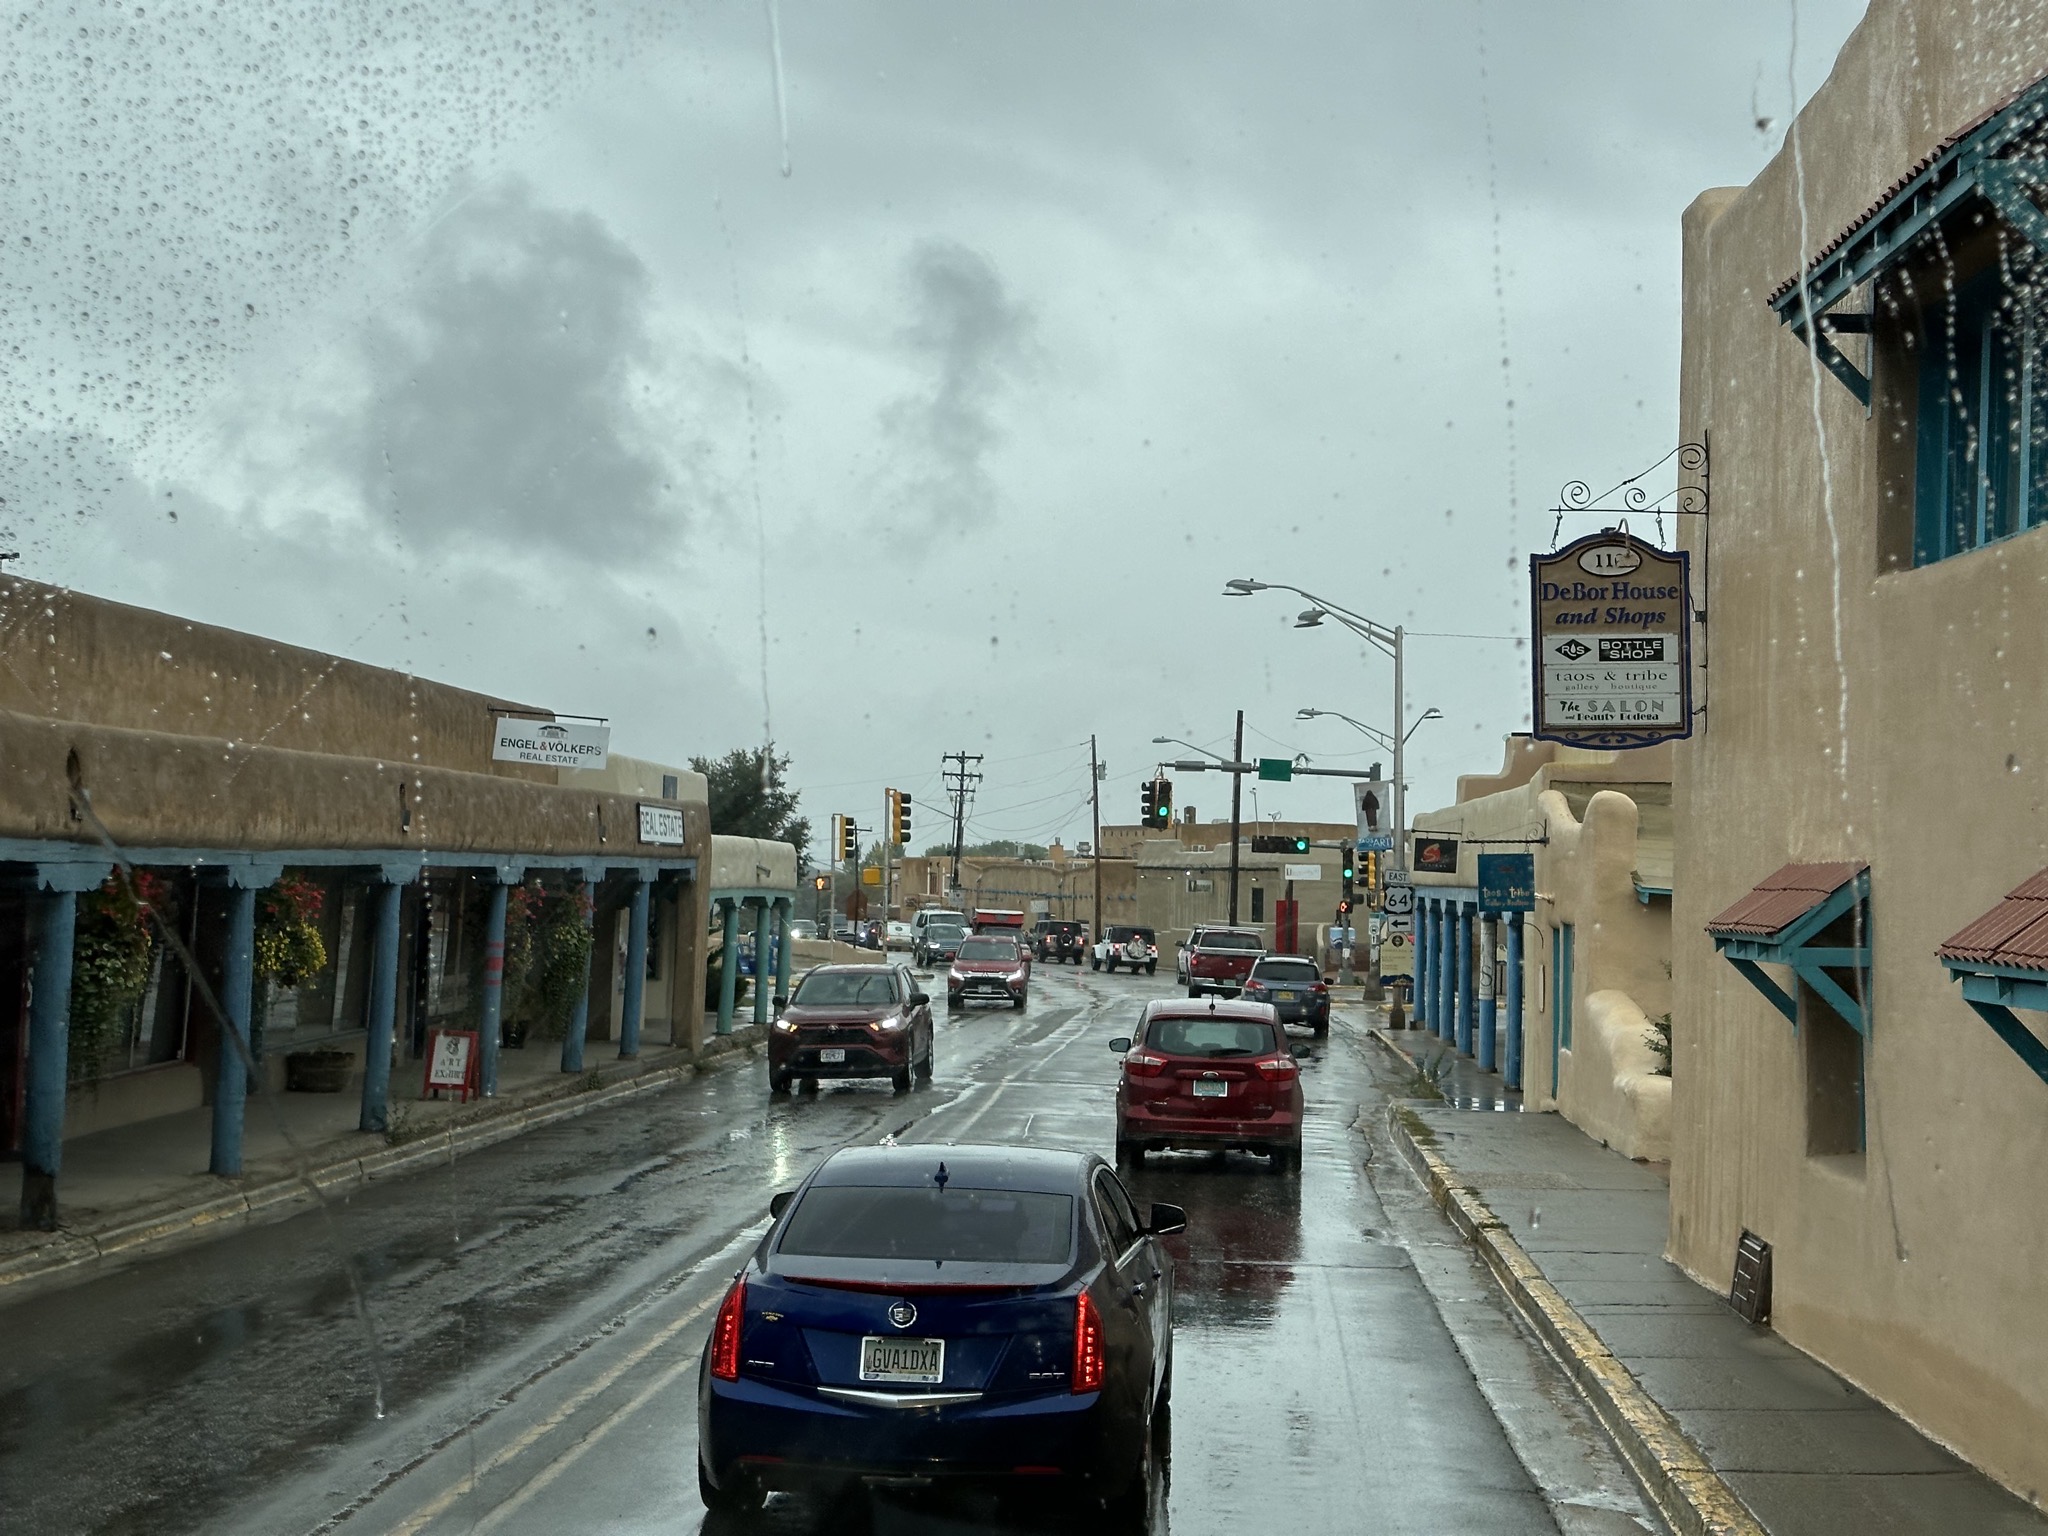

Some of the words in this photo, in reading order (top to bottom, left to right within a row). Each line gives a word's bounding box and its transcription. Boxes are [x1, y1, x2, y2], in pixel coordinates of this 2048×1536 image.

[1541, 582, 1609, 601] DeBor
[1611, 581, 1679, 600] House
[1555, 607, 1598, 625] and
[1604, 606, 1667, 630] Shops
[1600, 640, 1662, 650] BOTTLE
[1609, 649, 1655, 659] SHOP
[1556, 672, 1595, 681] taos
[1604, 670, 1616, 681] &
[1625, 669, 1668, 681] tribe
[1565, 683, 1599, 691] gallery
[1610, 682, 1658, 691] boutique
[1559, 700, 1580, 712] The
[1587, 699, 1664, 712] SALON
[1577, 712, 1615, 721] Beauty
[1620, 712, 1659, 721] Bodega
[519, 751, 544, 762] REAL
[545, 754, 579, 765] ESTATE
[640, 811, 659, 836] REAL
[659, 813, 683, 838] ESTATE
[1373, 837, 1390, 847] ART
[1388, 872, 1408, 882] EAST
[1388, 894, 1408, 907] 64
[440, 1058, 461, 1066] ART
[873, 1348, 938, 1372] GVA1DXA
